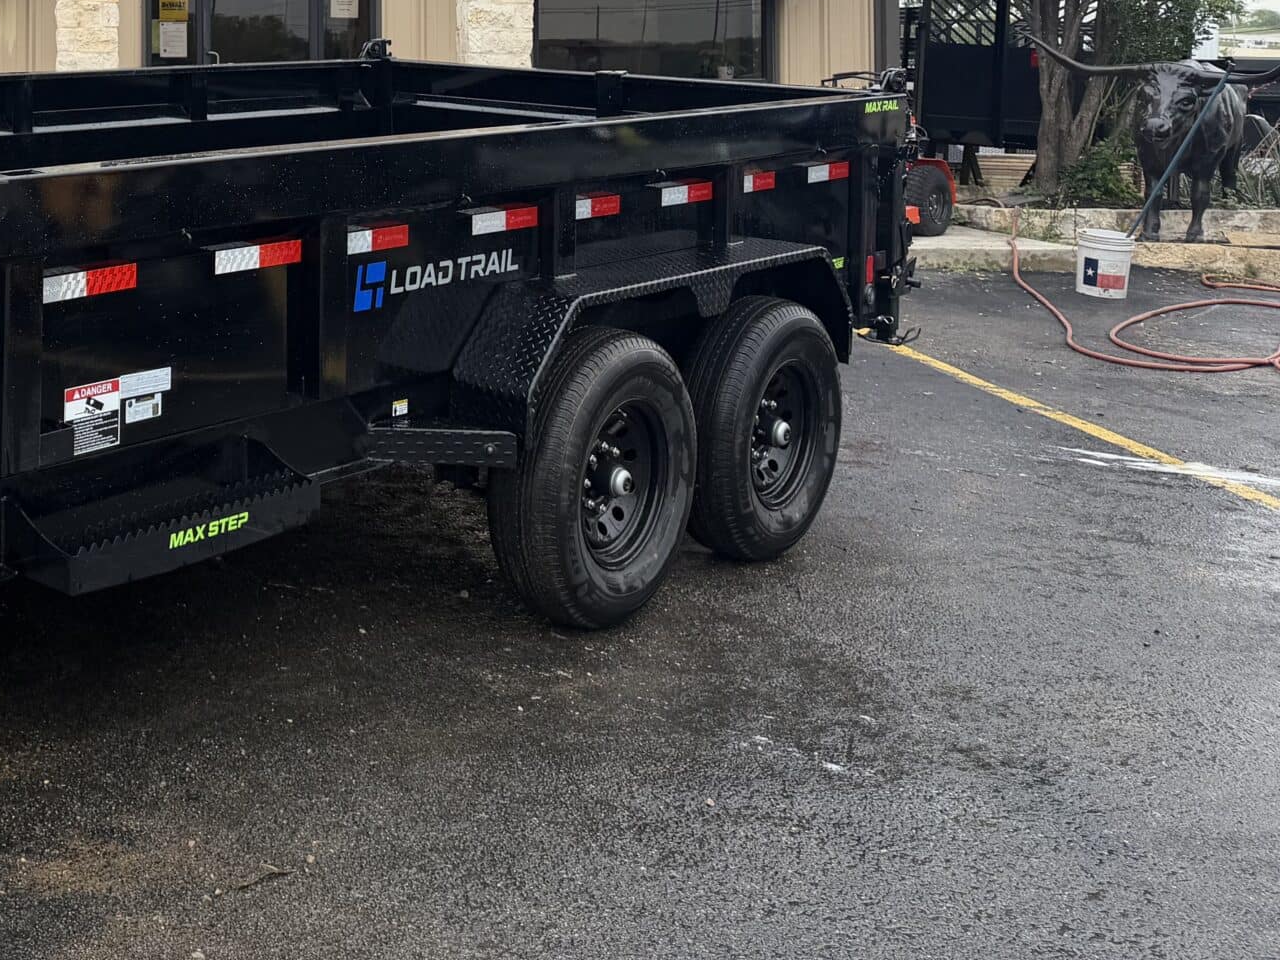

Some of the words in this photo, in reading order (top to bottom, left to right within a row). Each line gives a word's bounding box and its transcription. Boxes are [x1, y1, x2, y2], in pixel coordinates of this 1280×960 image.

[865, 101, 882, 113] MAX
[883, 100, 899, 111] RAIL
[390, 259, 453, 295] LOAD
[457, 248, 519, 281] TRAIL
[80, 383, 112, 398] DANGER
[169, 524, 206, 549] MAX
[208, 512, 248, 537] STEP
